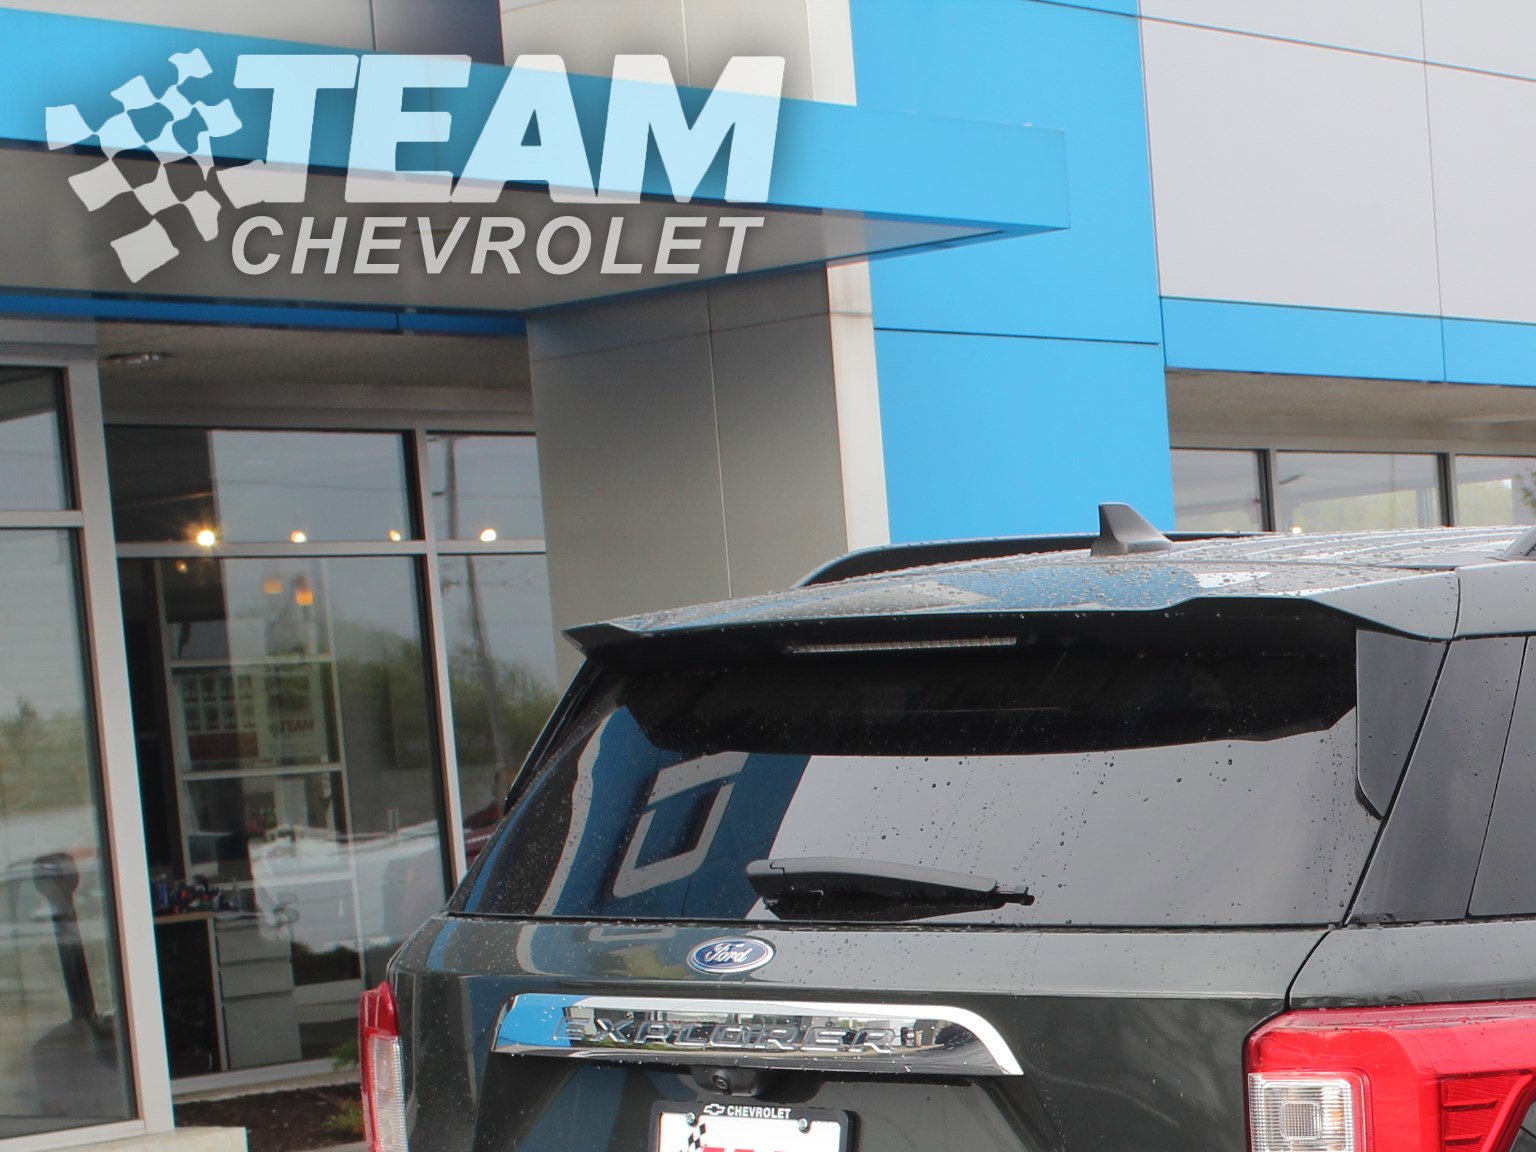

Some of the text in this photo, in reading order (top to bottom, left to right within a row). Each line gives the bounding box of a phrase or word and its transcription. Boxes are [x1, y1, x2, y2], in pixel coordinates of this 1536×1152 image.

[704, 943, 754, 963] Ford
[553, 1016, 896, 1055] EXPLORER
[726, 1104, 792, 1120] CHEVROLET
